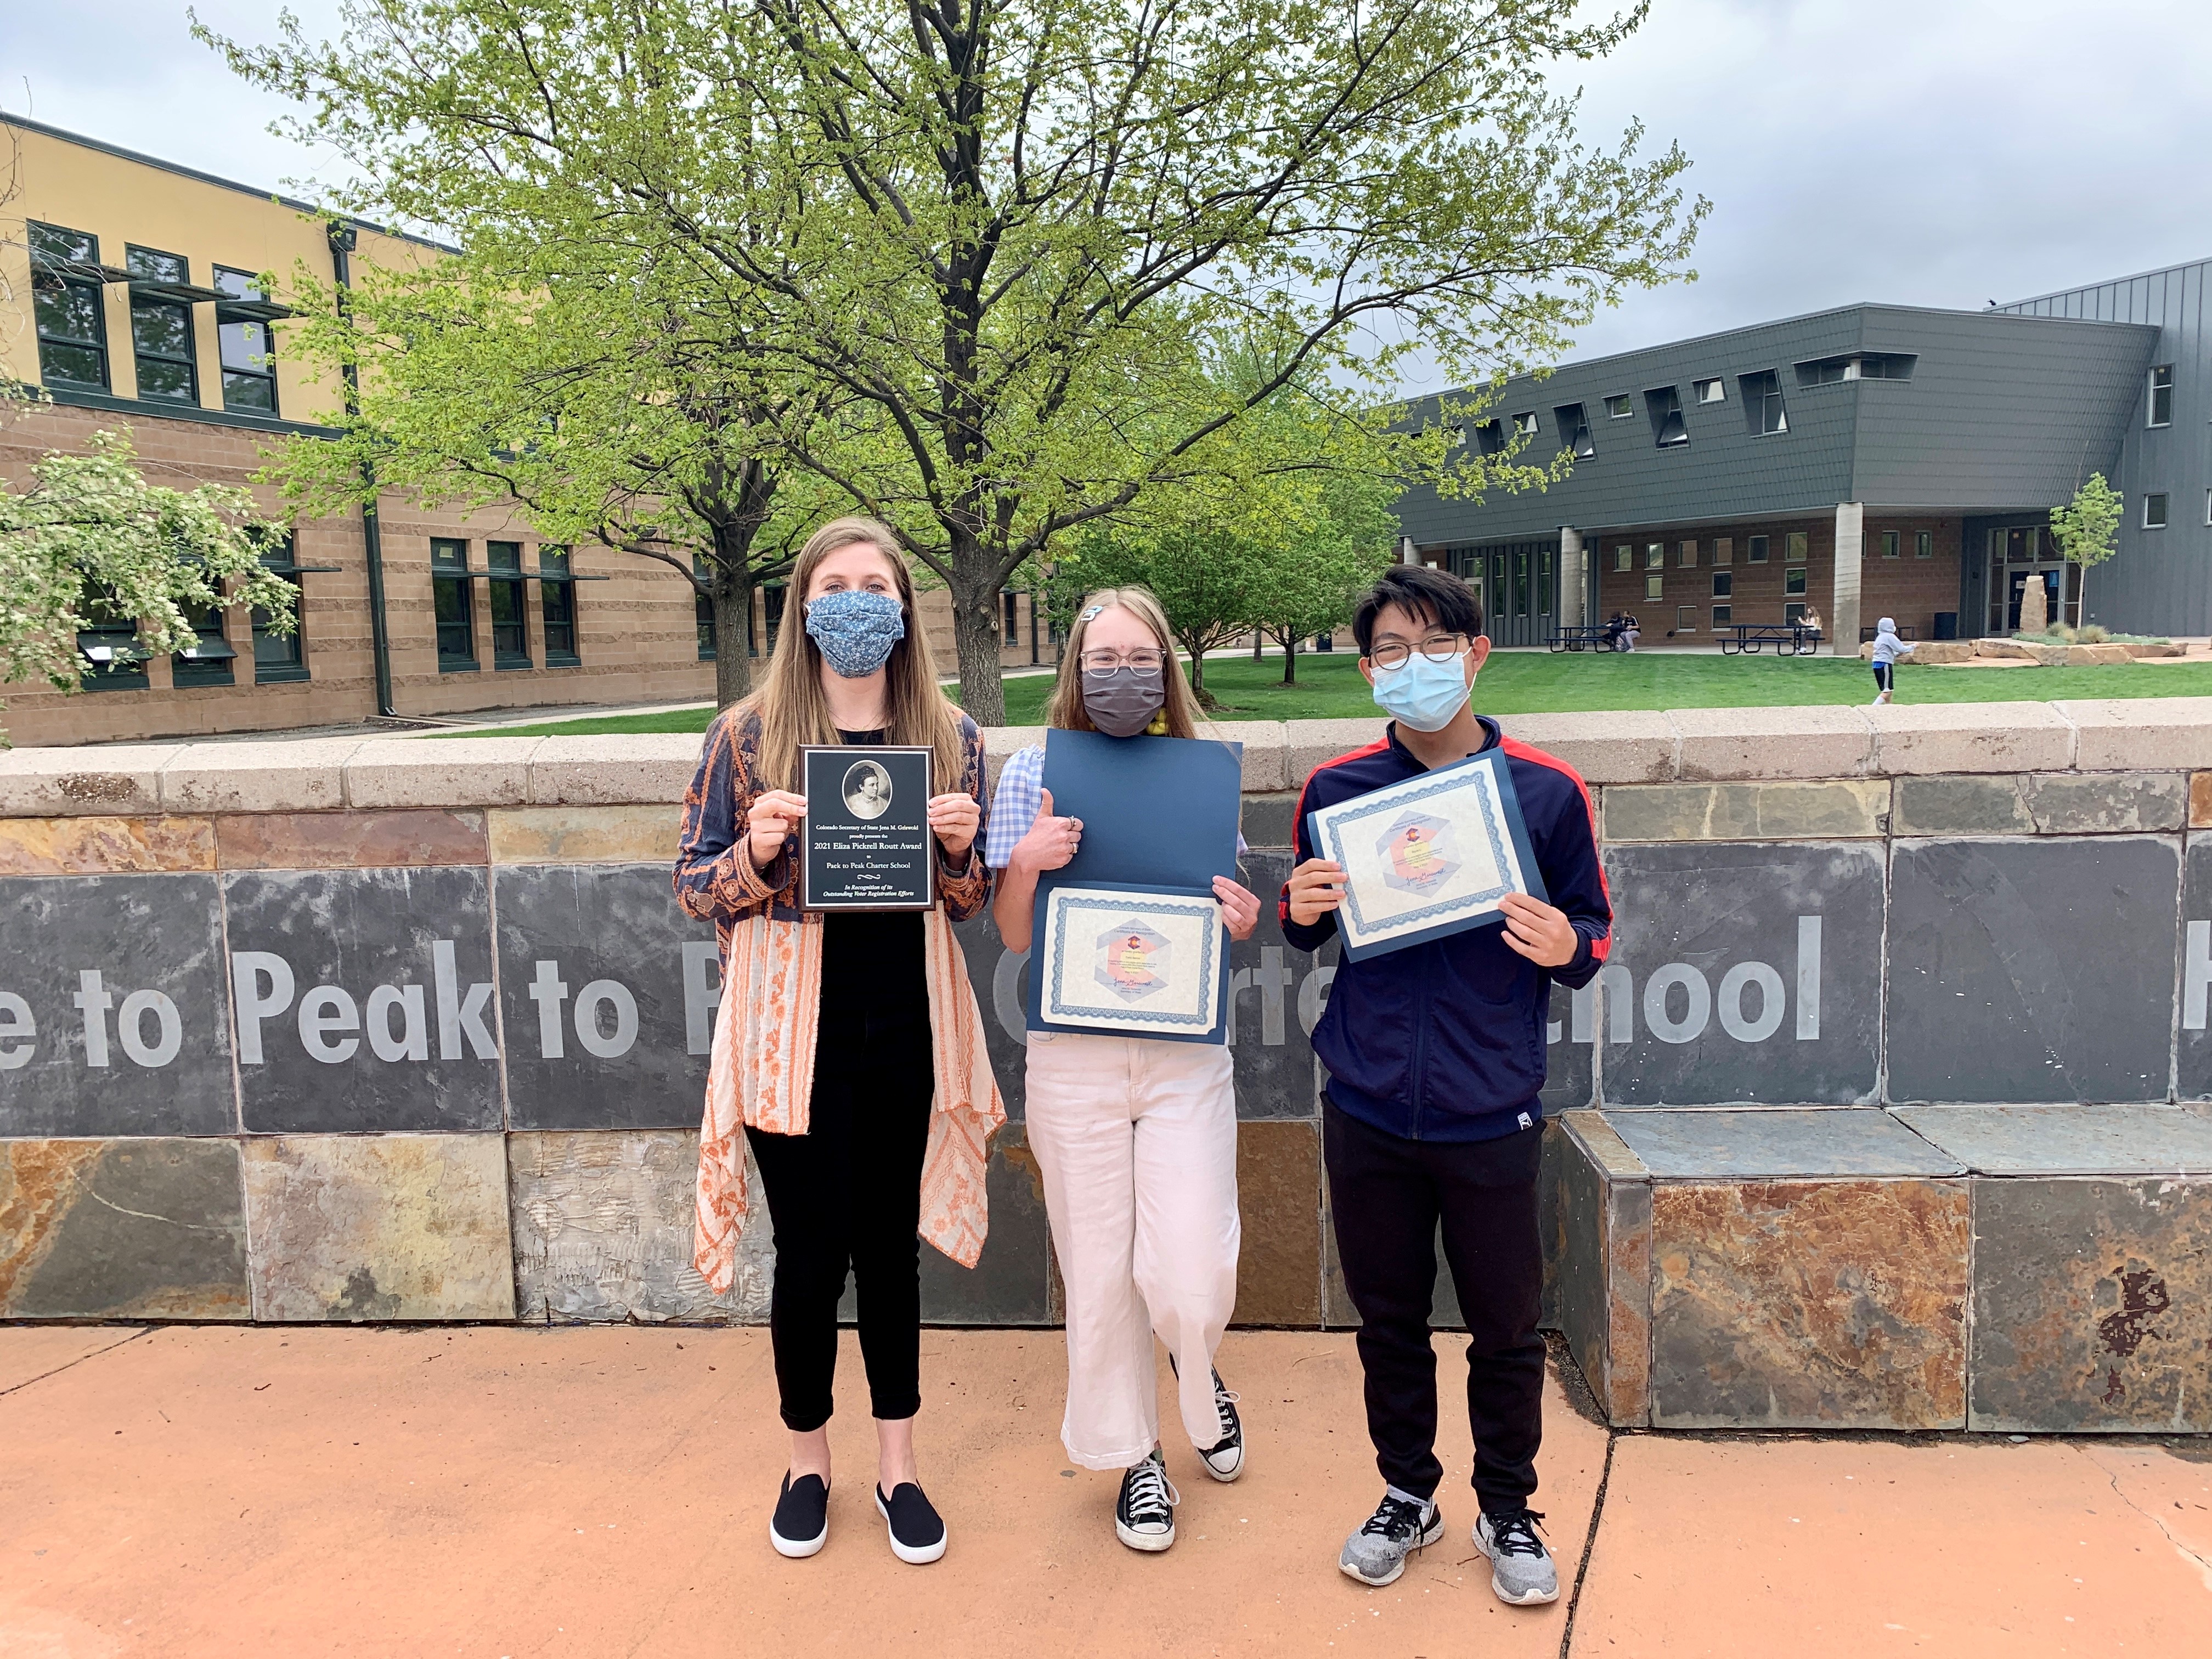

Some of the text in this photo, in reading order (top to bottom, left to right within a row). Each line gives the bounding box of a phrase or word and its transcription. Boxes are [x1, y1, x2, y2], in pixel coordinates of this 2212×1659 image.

[74, 969, 183, 1068] to
[232, 939, 500, 1064] Peak
[528, 960, 639, 1058] to
